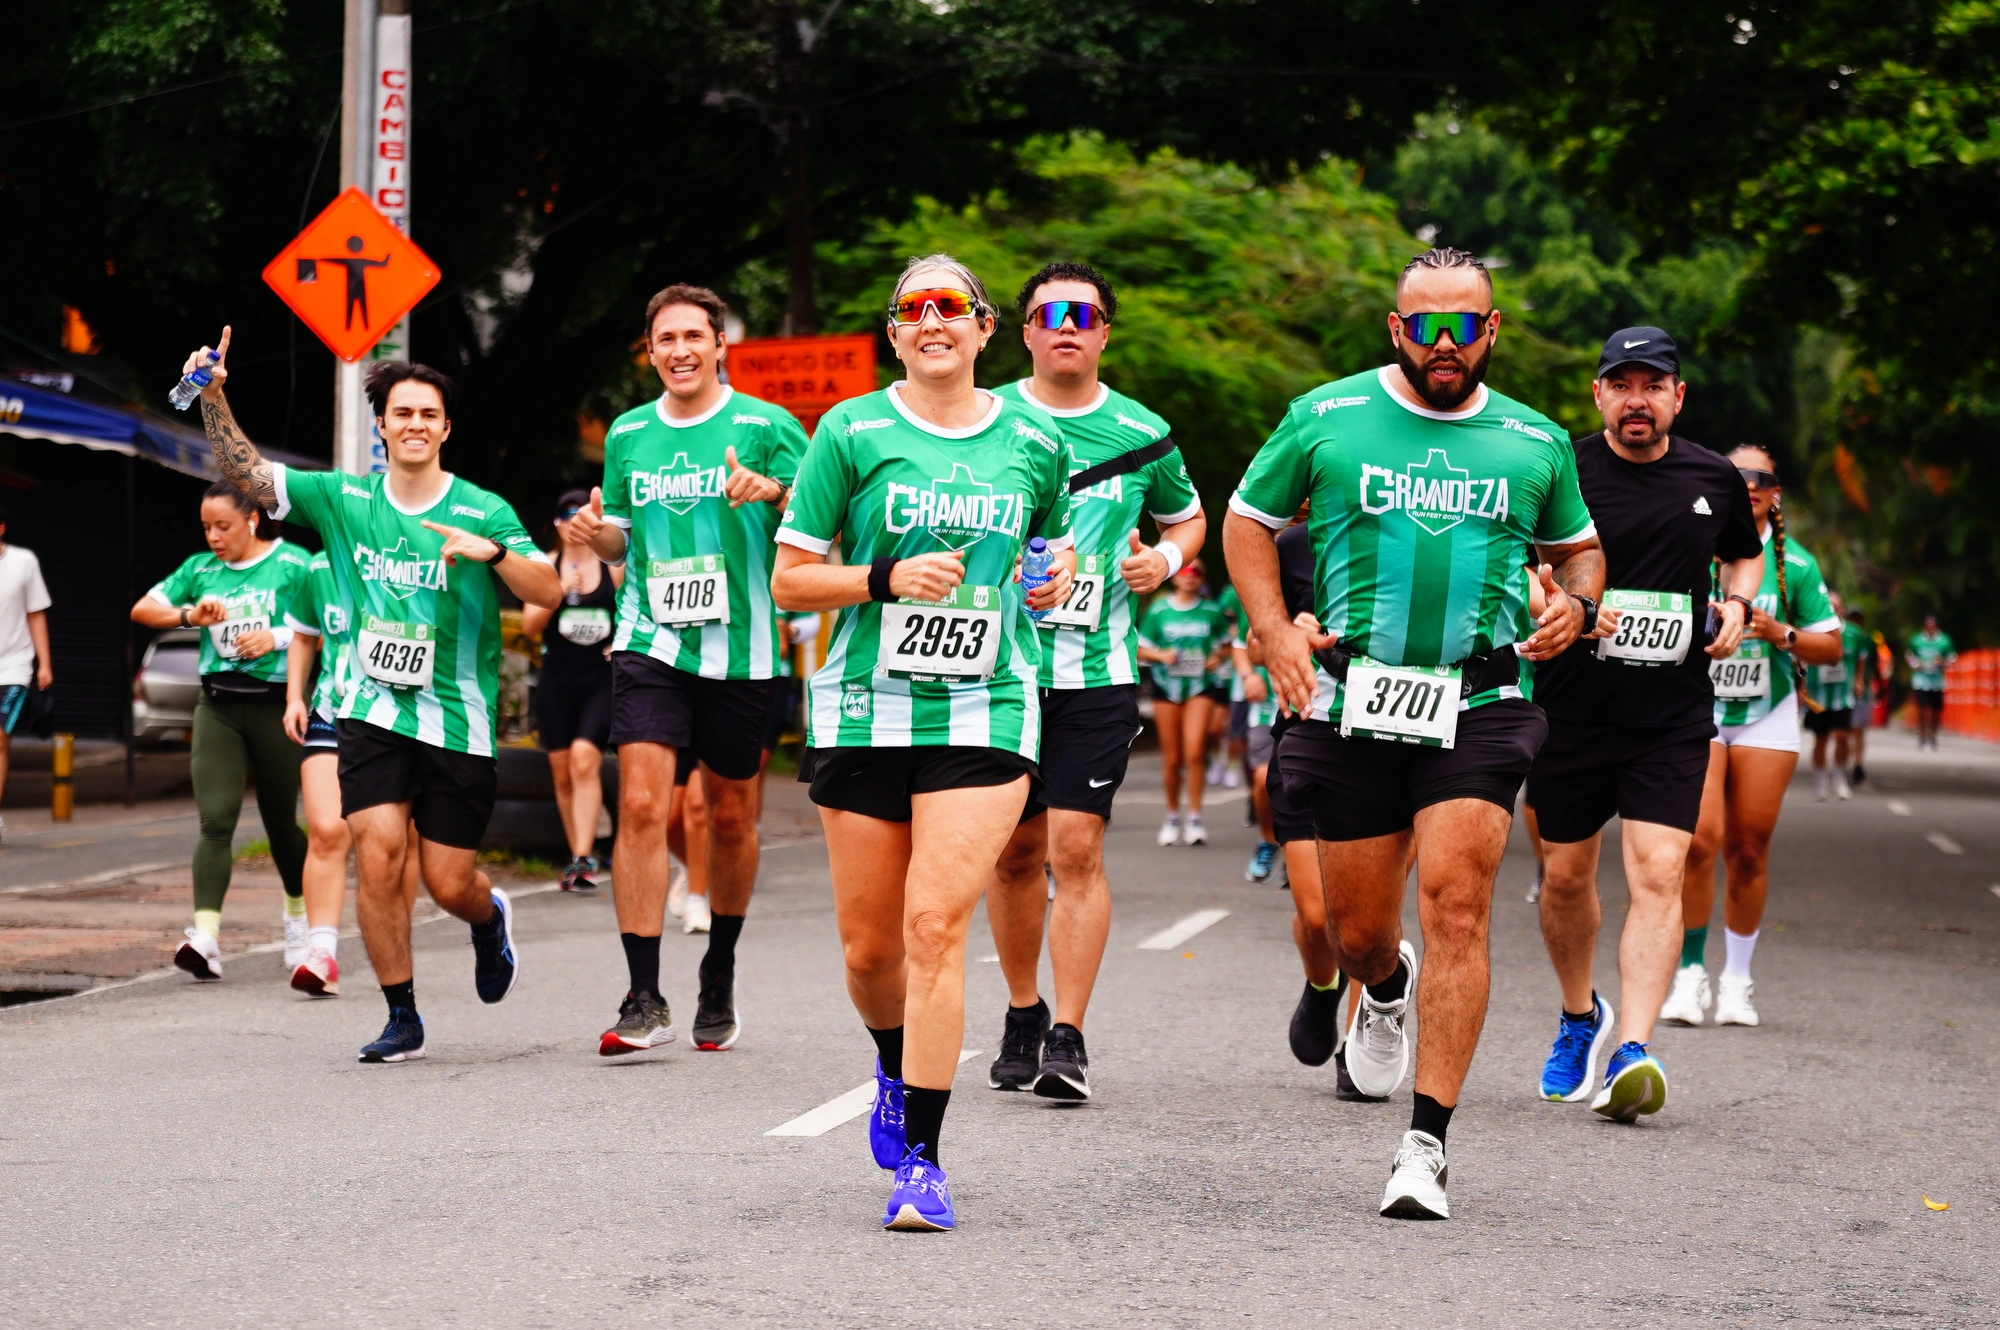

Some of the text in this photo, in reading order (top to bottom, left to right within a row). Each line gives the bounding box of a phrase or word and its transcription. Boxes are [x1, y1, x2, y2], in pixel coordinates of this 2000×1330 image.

[762, 379, 838, 399] OBRA
[1317, 397, 1338, 418] JFK
[1503, 418, 1524, 433] JFK
[1016, 425, 1037, 441] JFK
[631, 465, 727, 507] GRANDEZA
[1359, 463, 1509, 522] GRANDEZA
[885, 481, 1024, 539] GRANDEZA
[354, 542, 448, 592] GRANDEZA
[663, 578, 716, 612] 4108
[974, 594, 988, 603] 11K
[897, 613, 989, 661] 2953
[1615, 615, 1683, 651] 3350
[368, 639, 427, 675] 4636
[1712, 663, 1762, 687] 4904
[1366, 676, 1446, 722] 3701
